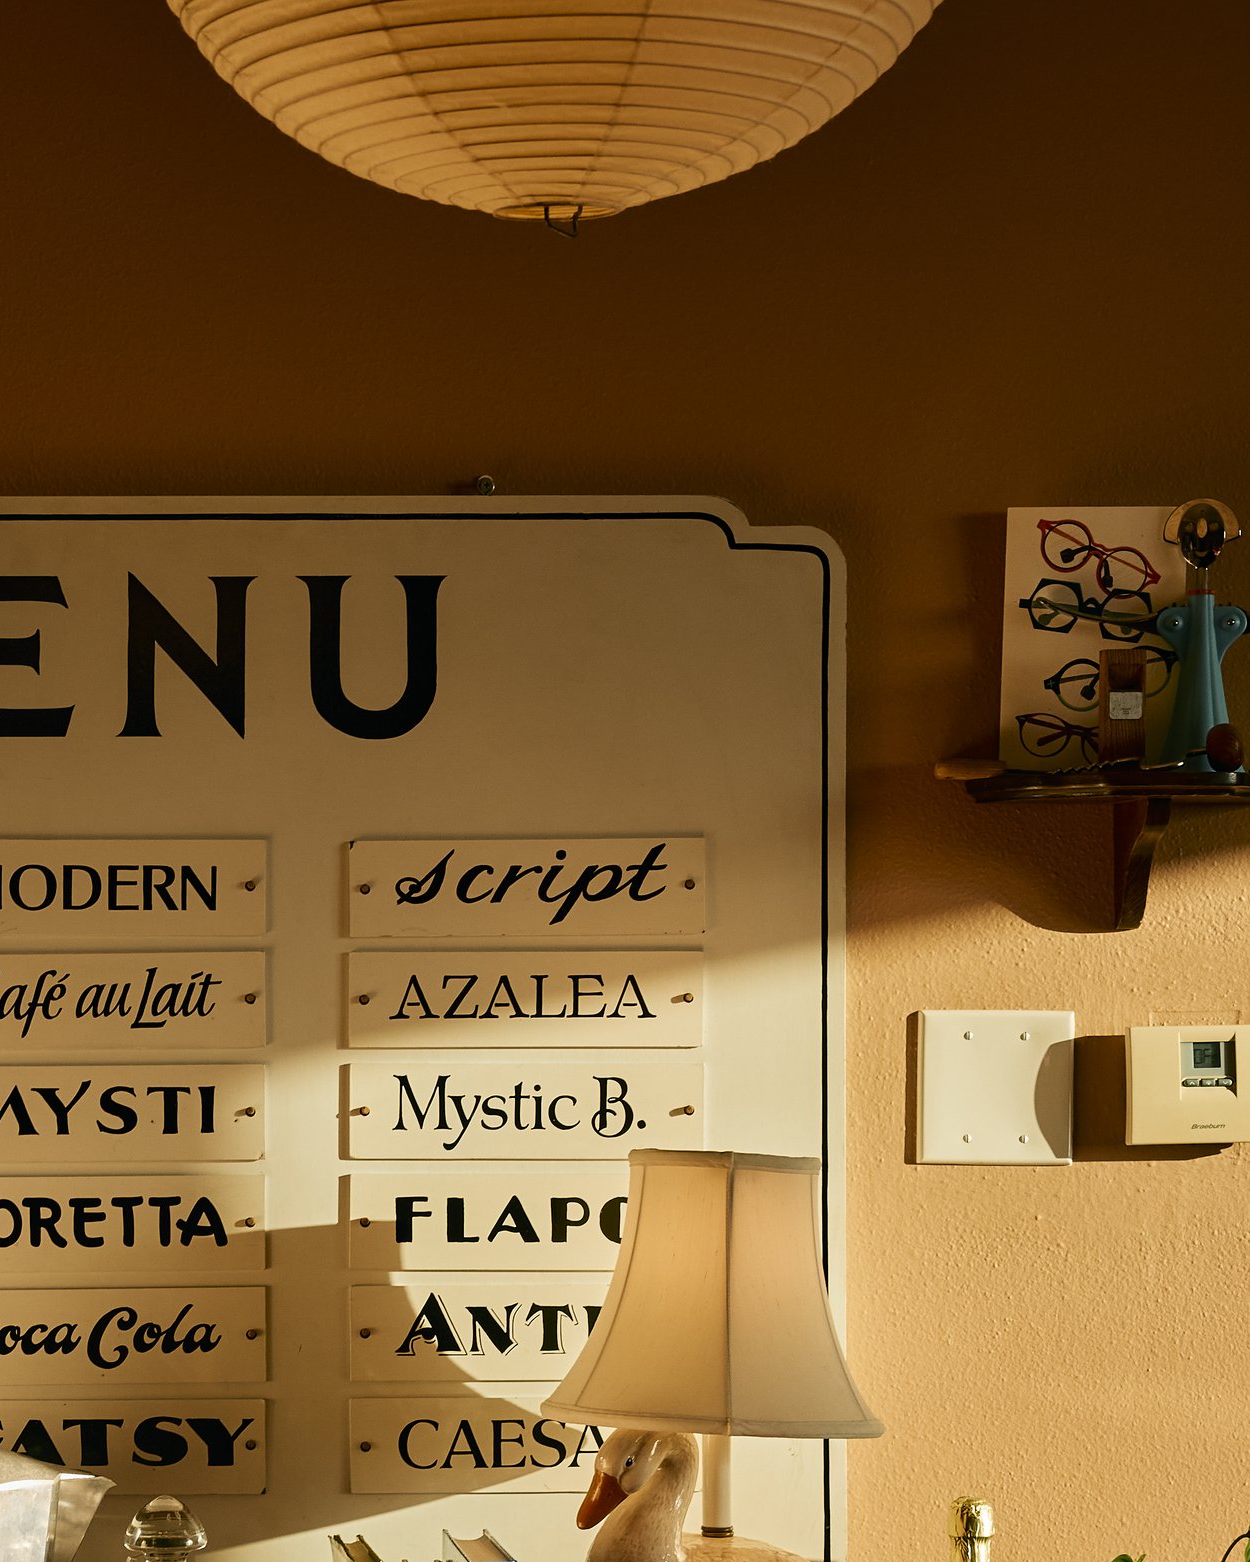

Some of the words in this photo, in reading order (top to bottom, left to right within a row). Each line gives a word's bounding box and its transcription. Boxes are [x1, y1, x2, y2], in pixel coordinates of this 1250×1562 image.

[394, 842, 669, 926] script
[74, 979, 131, 1019] au
[129, 966, 223, 1030] Lait
[388, 973, 657, 1021] AZALEA
[391, 1074, 581, 1151] Mystic
[591, 1075, 648, 1138] B.
[85, 1304, 222, 1373] Cola
[395, 1291, 601, 1358] ANT
[398, 1417, 606, 1470] CAESA
